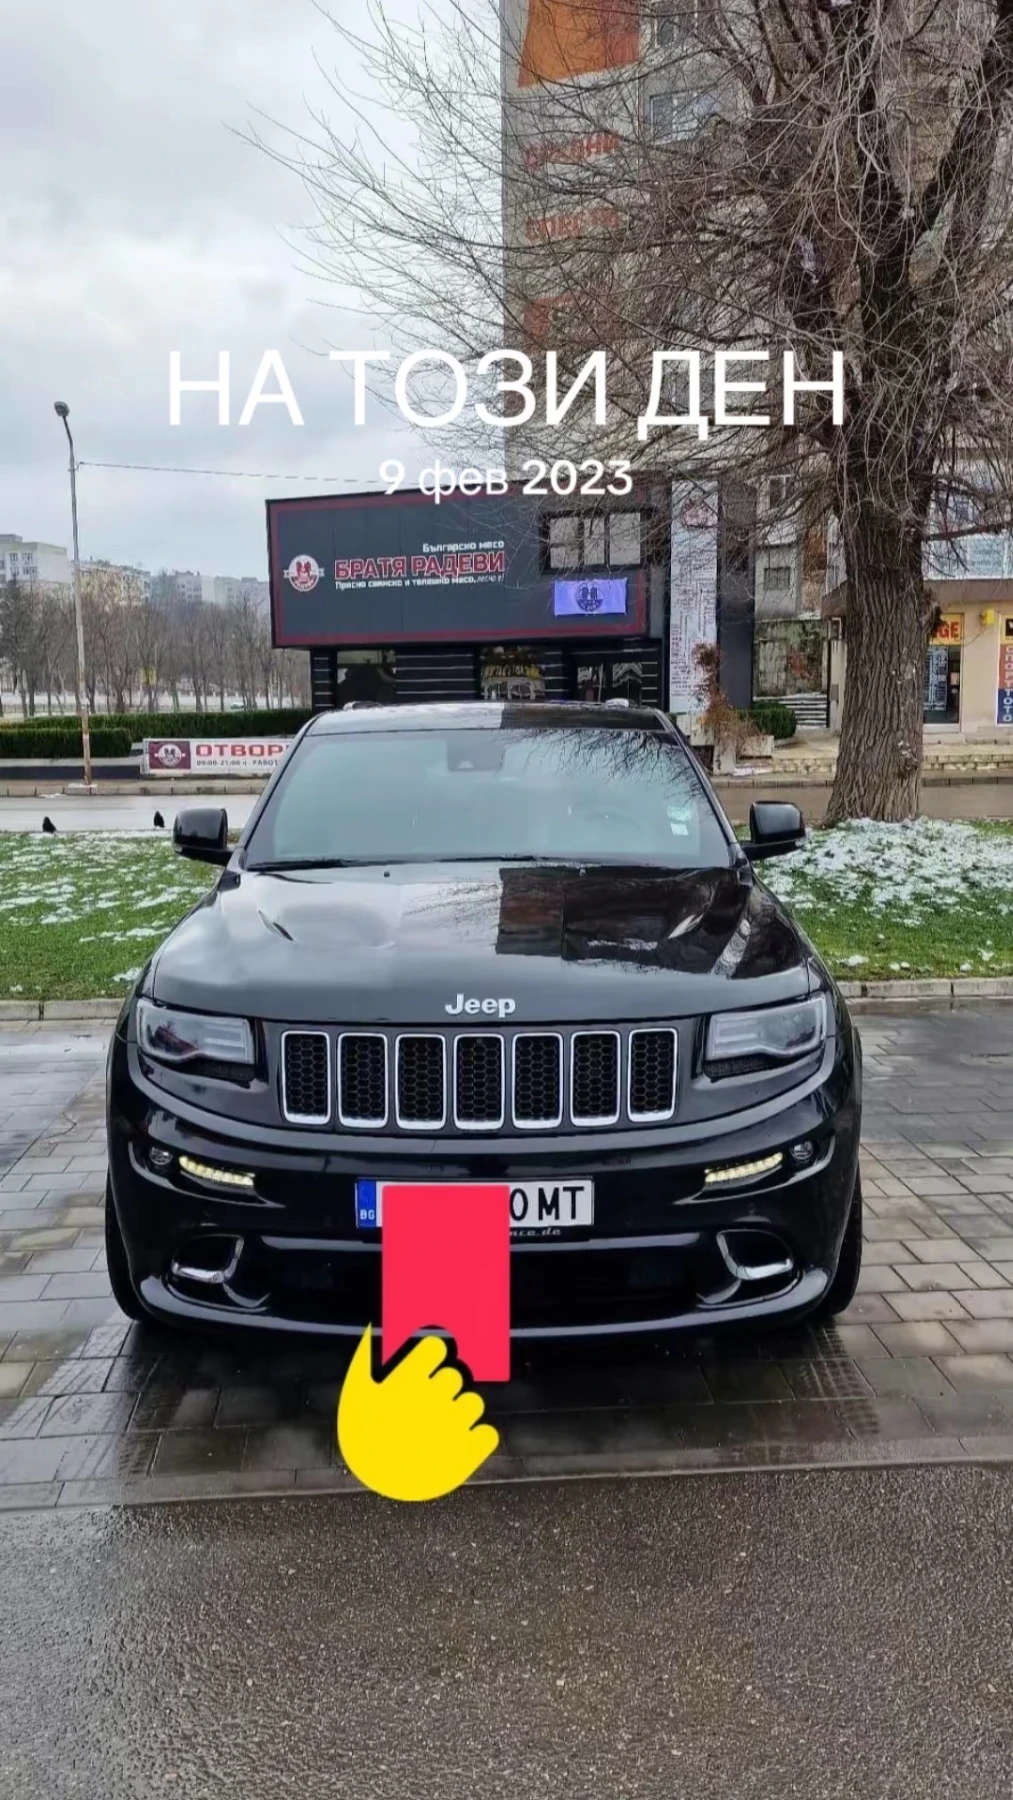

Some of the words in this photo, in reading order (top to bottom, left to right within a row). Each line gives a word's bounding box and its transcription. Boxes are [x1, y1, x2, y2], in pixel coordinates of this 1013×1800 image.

[422, 542, 477, 553] Българско
[479, 540, 505, 550] месо
[334, 556, 407, 581] БРАТЯ
[410, 551, 506, 579] РАДЕВИ
[335, 580, 366, 591] Прясно
[931, 620, 959, 639] GE
[1003, 688, 1013, 722] ТОТО
[195, 744, 289, 757] ОТВОР
[445, 993, 516, 1018] Jeep
[360, 1209, 375, 1220] BG
[509, 1227, 561, 1236] nce.de
